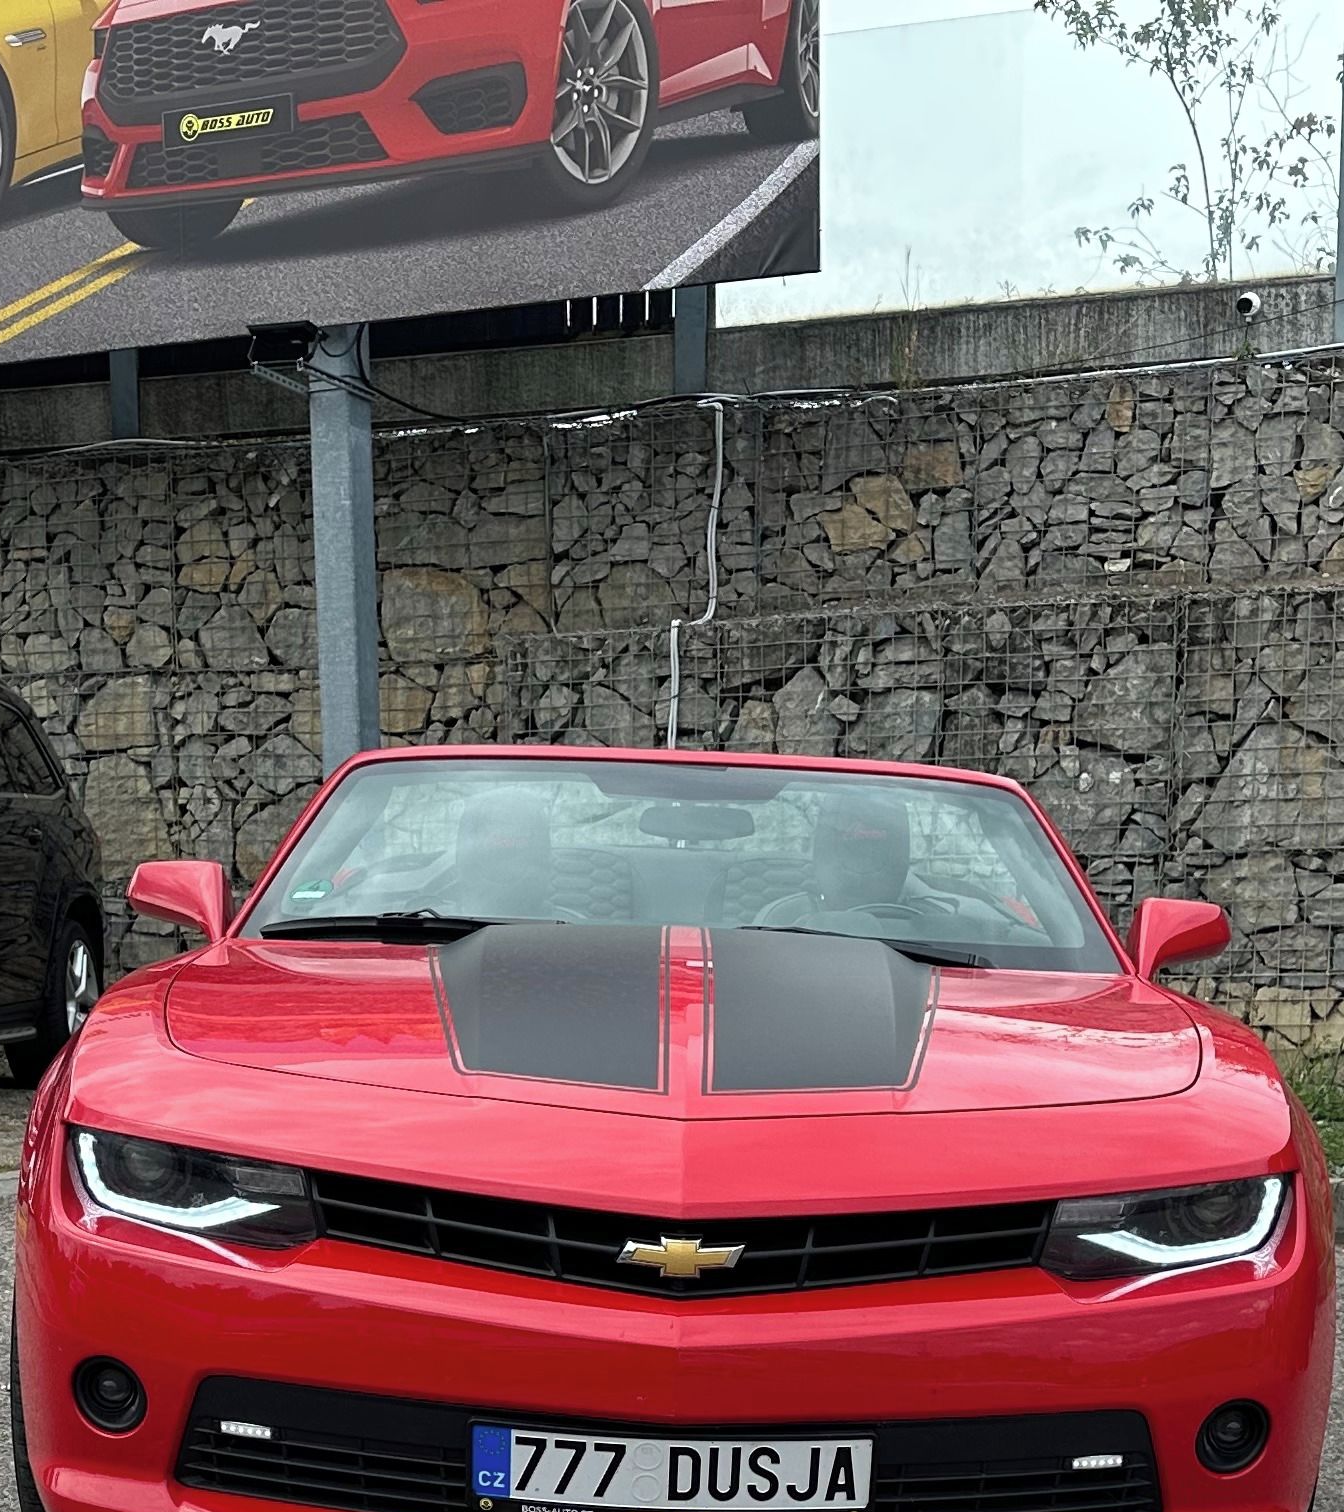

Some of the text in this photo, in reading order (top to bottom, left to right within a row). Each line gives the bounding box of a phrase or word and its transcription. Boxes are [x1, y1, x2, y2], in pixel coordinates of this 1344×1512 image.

[201, 111, 271, 131] BOSS AUTO
[514, 1435, 857, 1502] 777 DUSJA
[477, 1470, 505, 1488] CZ
